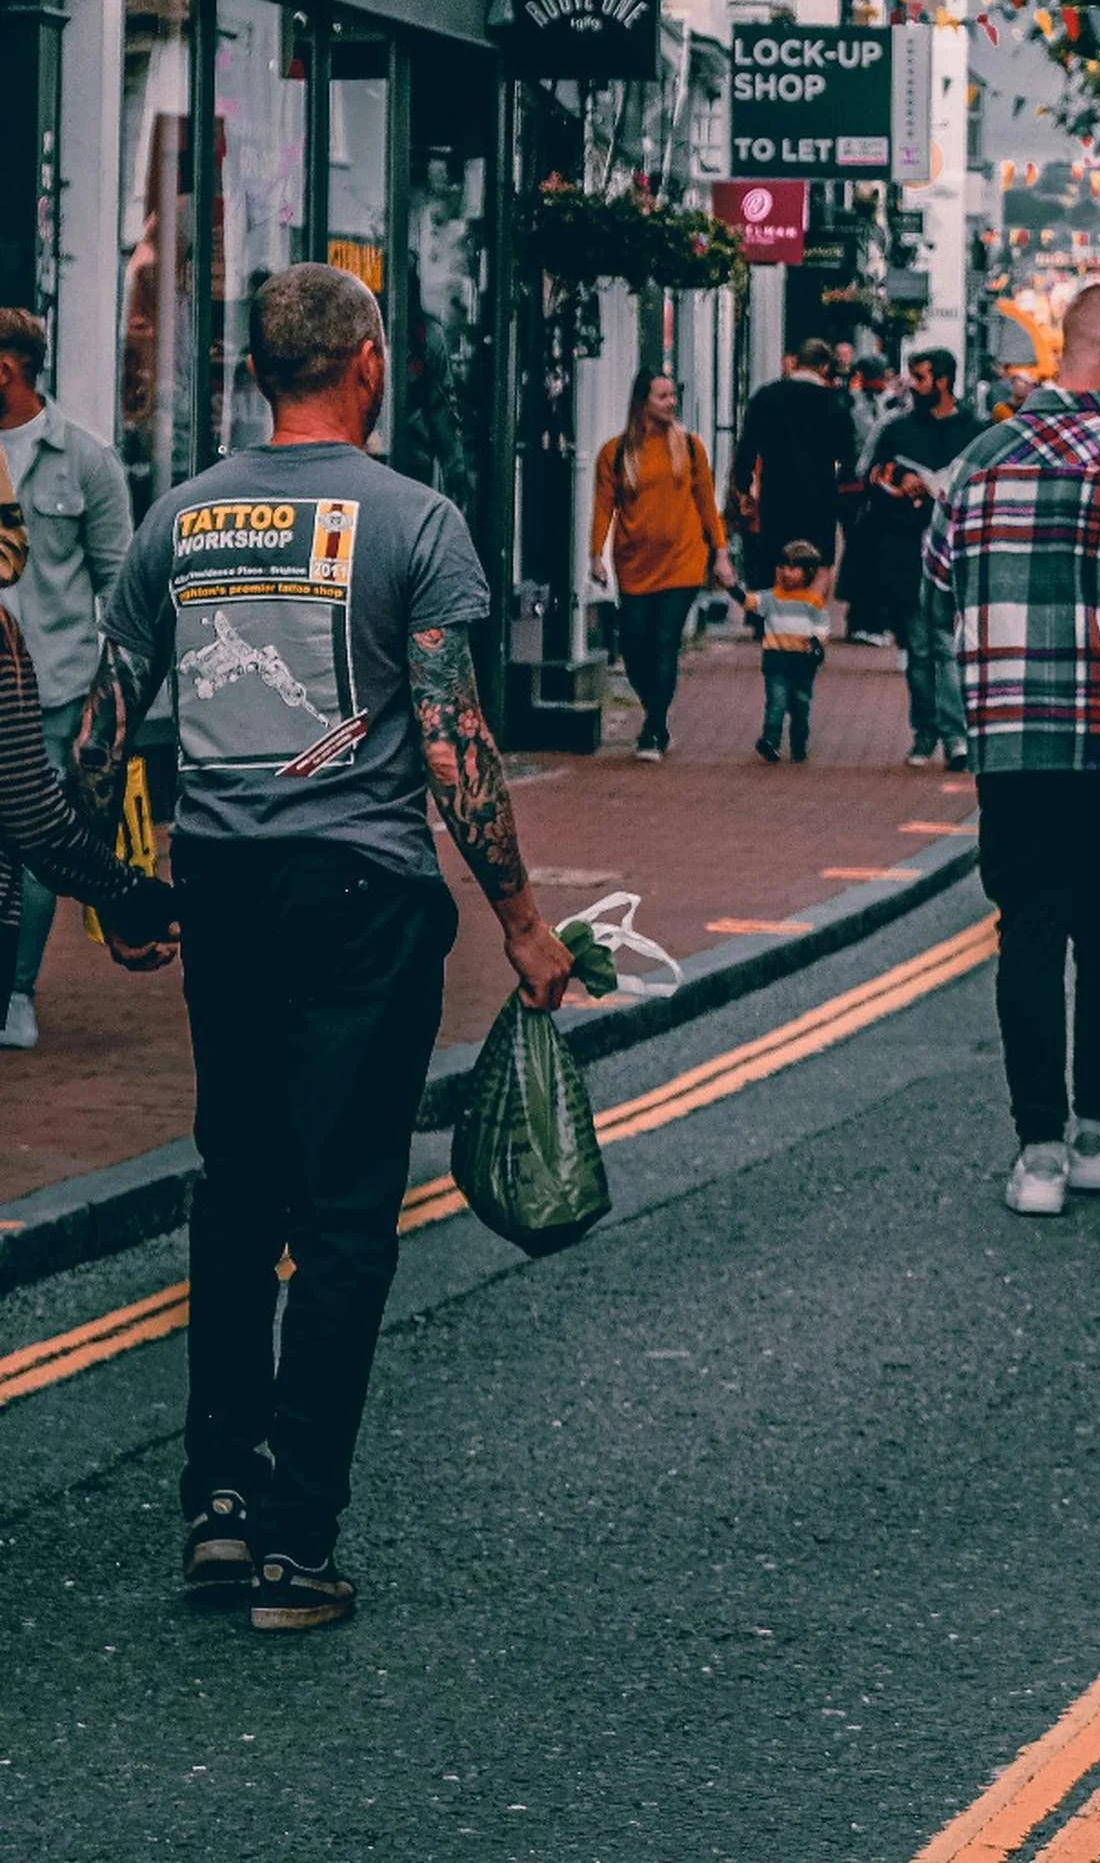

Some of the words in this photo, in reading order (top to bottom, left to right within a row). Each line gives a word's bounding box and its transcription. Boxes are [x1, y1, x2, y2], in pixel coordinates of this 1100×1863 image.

[734, 38, 883, 68] LOCK-UP
[734, 72, 827, 103] SHOP
[734, 137, 776, 162] TO
[782, 138, 833, 163] LET
[180, 504, 296, 537] TATTOO
[177, 529, 294, 557] WORKSHOP
[313, 586, 344, 598] shop
